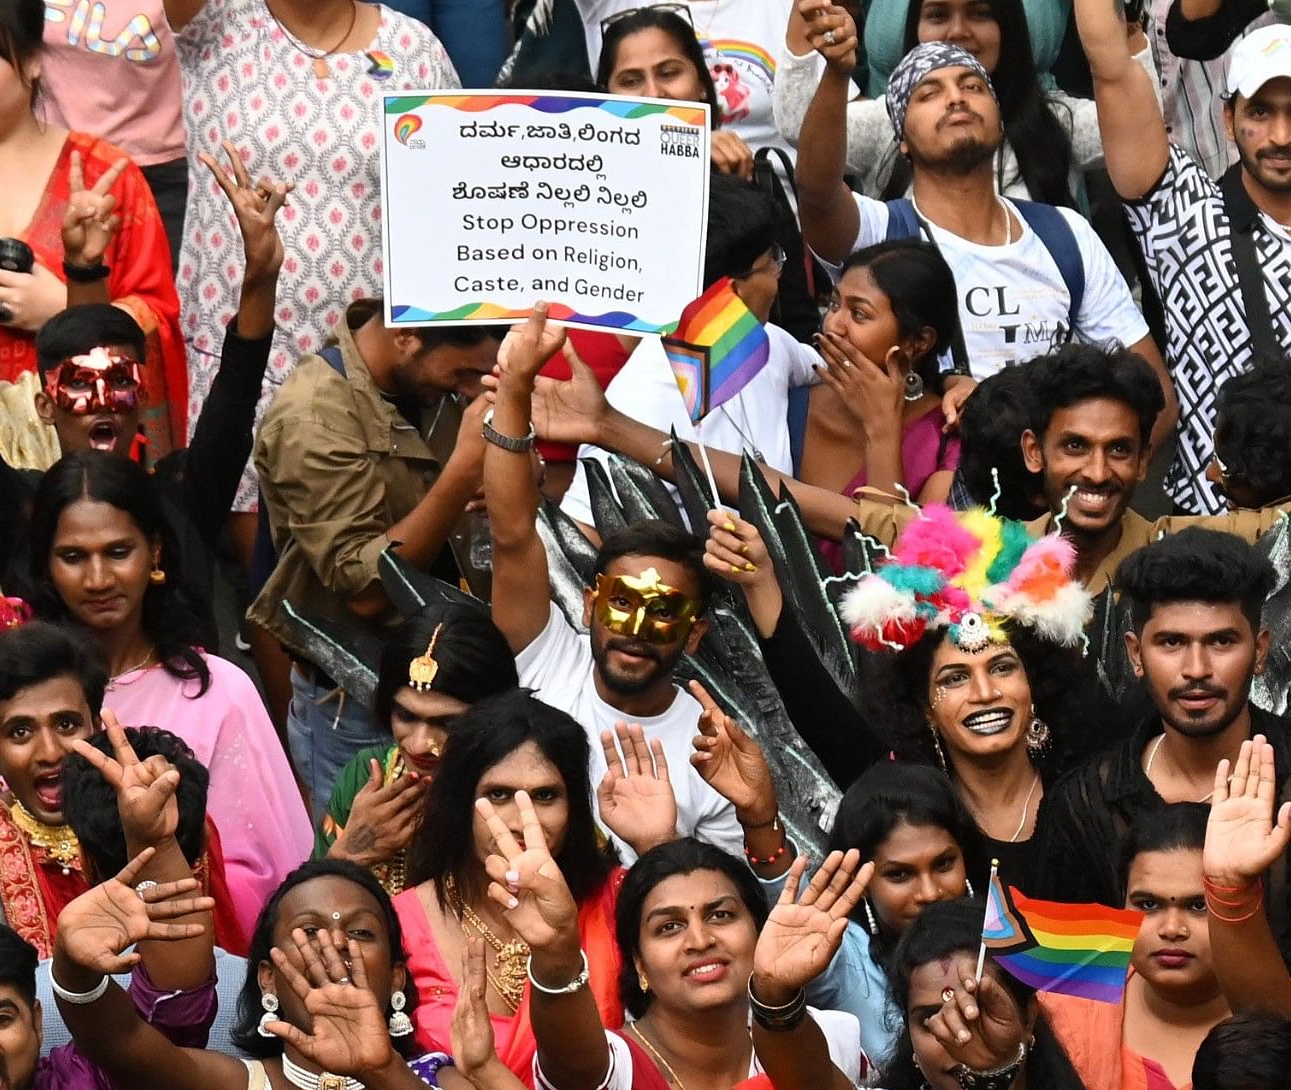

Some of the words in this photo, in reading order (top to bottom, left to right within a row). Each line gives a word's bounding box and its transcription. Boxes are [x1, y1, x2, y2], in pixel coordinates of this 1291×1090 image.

[660, 142, 700, 158] HABBA
[500, 153, 607, 181] ಆಧಾರದಲ್ಲಿ
[462, 214, 514, 233] Stop
[521, 213, 638, 239] Oppression
[457, 244, 525, 261] Based
[532, 246, 557, 261] on
[564, 246, 643, 273] Religion,
[454, 276, 525, 293] Caste,
[532, 277, 568, 292] and
[575, 279, 645, 302] Gender
